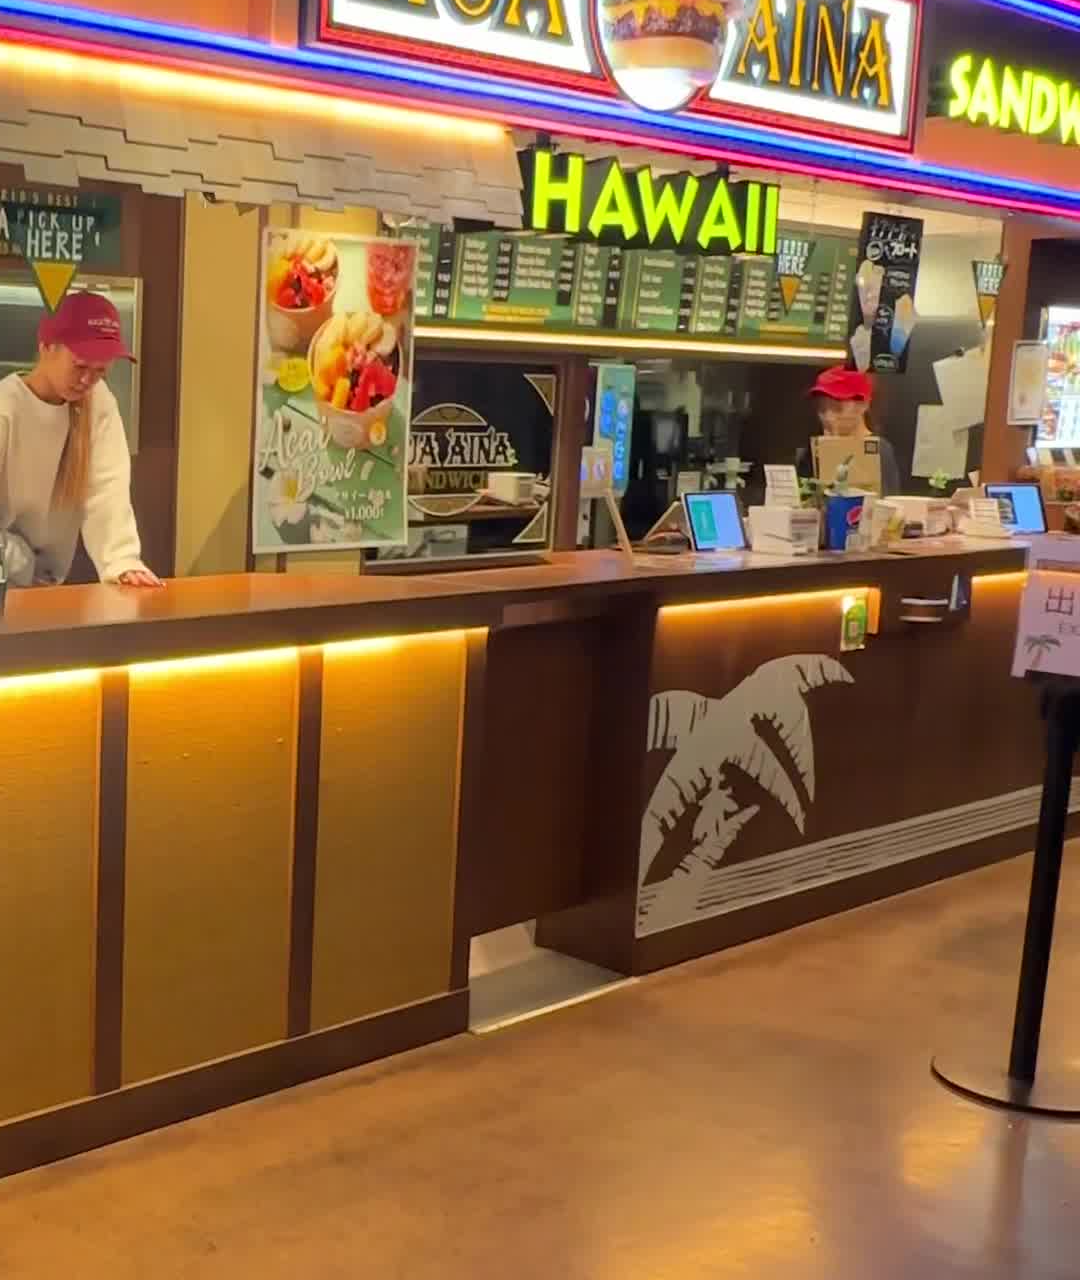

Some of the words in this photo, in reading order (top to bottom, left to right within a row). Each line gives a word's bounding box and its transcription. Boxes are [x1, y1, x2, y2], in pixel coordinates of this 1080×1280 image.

[532, 150, 779, 255] HAWAII
[71, 215, 96, 233] UP
[25, 229, 84, 262] HERE
[1045, 586, 1075, 616] 出
